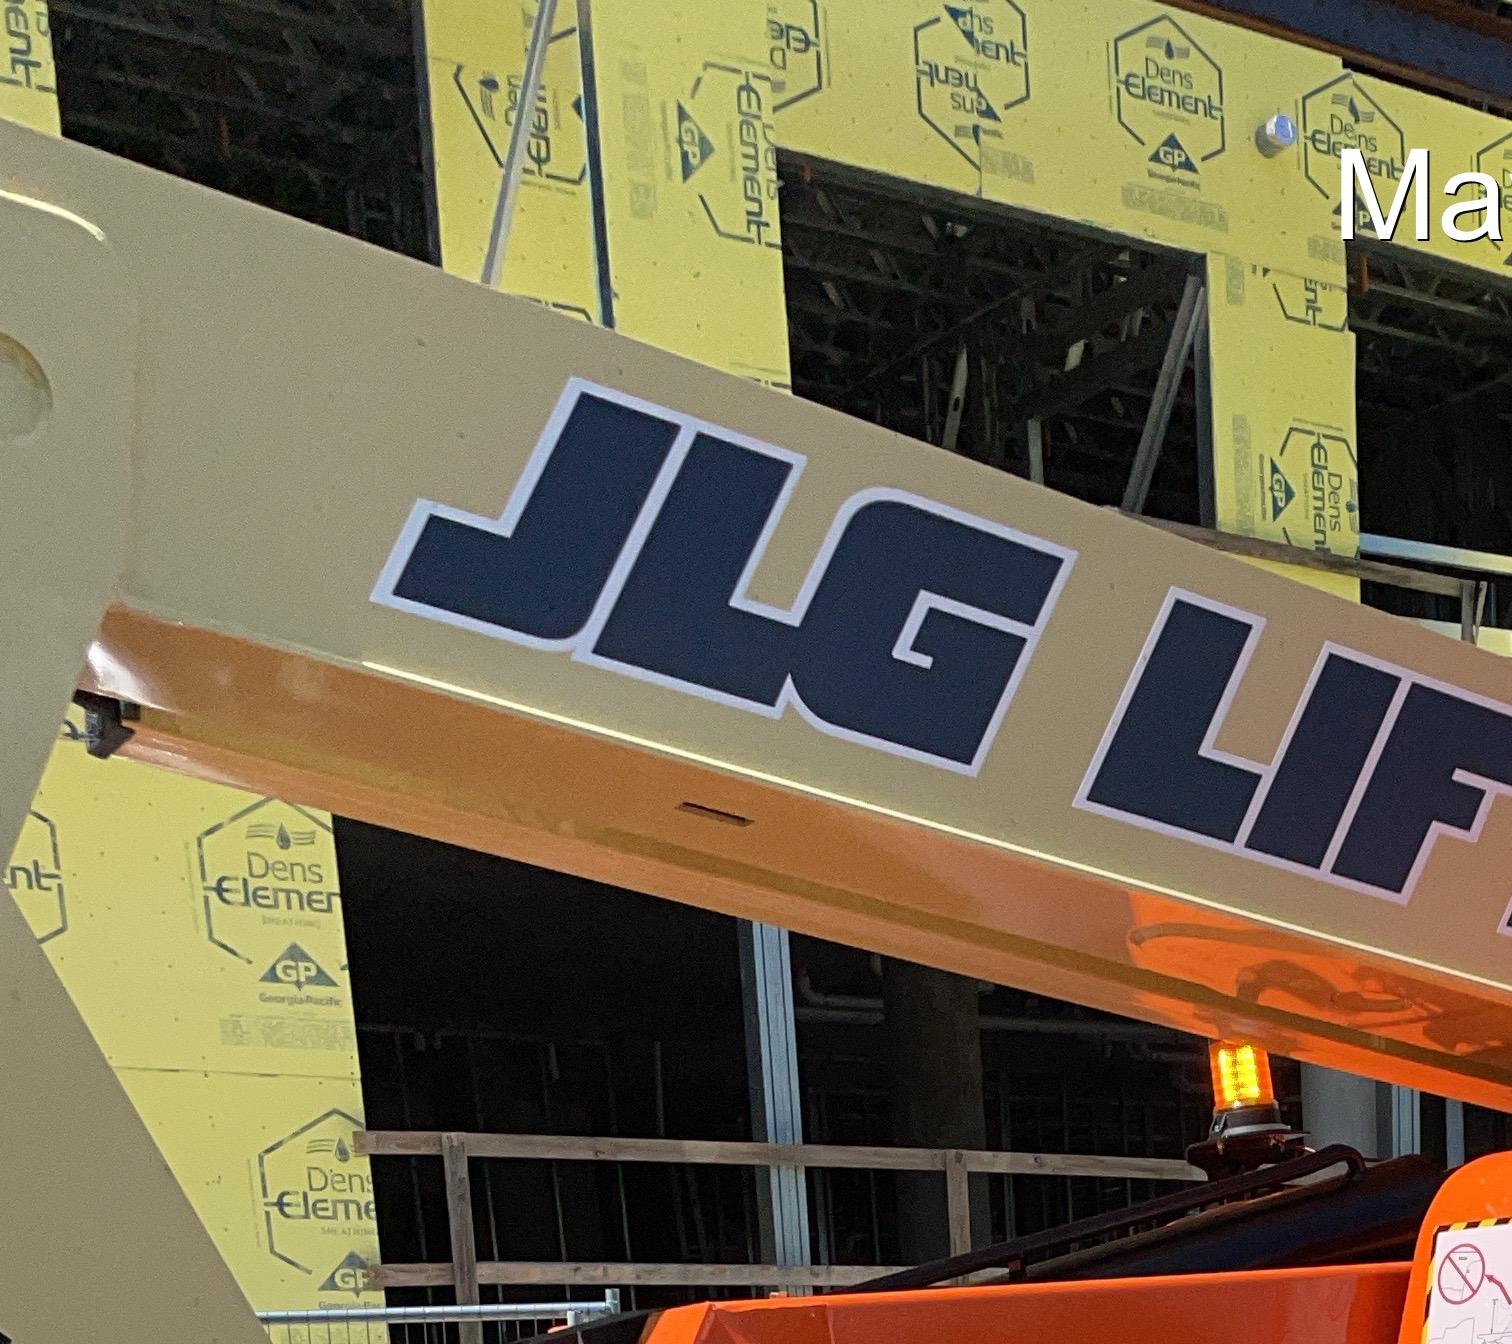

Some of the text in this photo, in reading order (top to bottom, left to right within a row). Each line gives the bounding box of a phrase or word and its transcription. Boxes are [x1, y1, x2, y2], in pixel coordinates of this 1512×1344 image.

[1144, 56, 1194, 90] Dens
[1117, 71, 1222, 121] Element
[681, 118, 703, 168] GP
[734, 72, 772, 244] Element
[1157, 147, 1187, 168] GP
[1271, 472, 1286, 509] GP
[1310, 433, 1329, 551] Elemen
[1328, 471, 1343, 533] Dens
[370, 375, 1078, 777] JLG
[247, 850, 325, 884] Dens
[203, 874, 342, 914] Elemen
[274, 959, 319, 983] GP
[264, 1189, 377, 1221] Eleme
